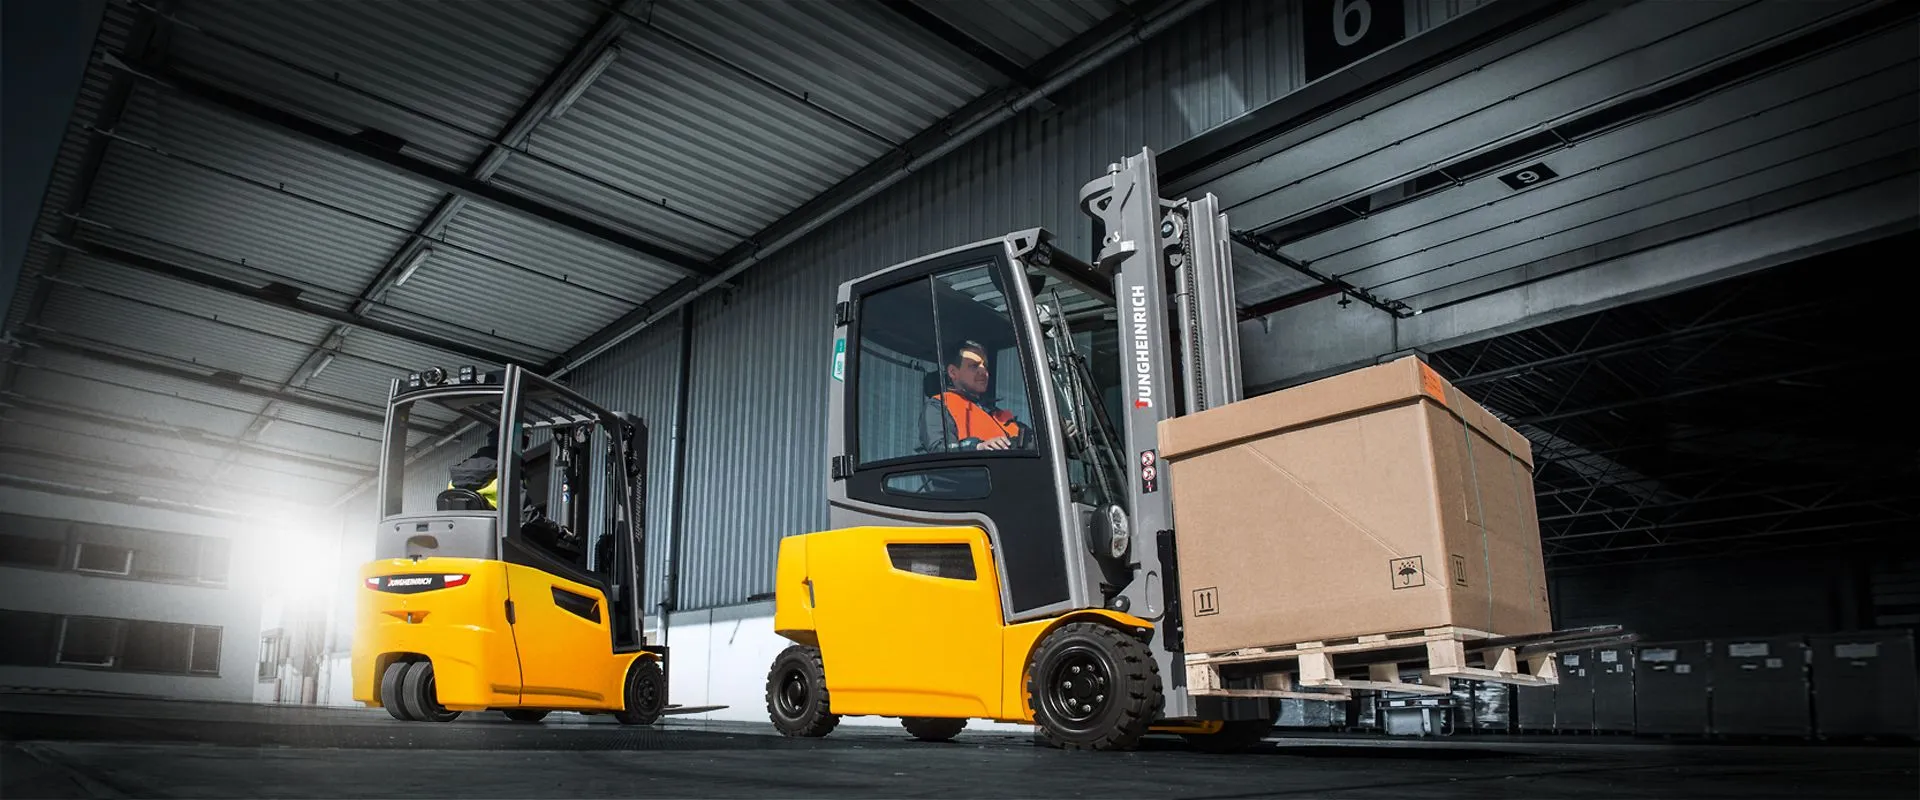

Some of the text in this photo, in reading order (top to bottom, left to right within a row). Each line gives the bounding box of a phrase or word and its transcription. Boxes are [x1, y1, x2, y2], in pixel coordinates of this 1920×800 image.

[1333, 0, 1372, 47] 6
[1131, 285, 1153, 409] JUNGHEINRICH
[387, 577, 433, 587] JUNGHEINRICH
